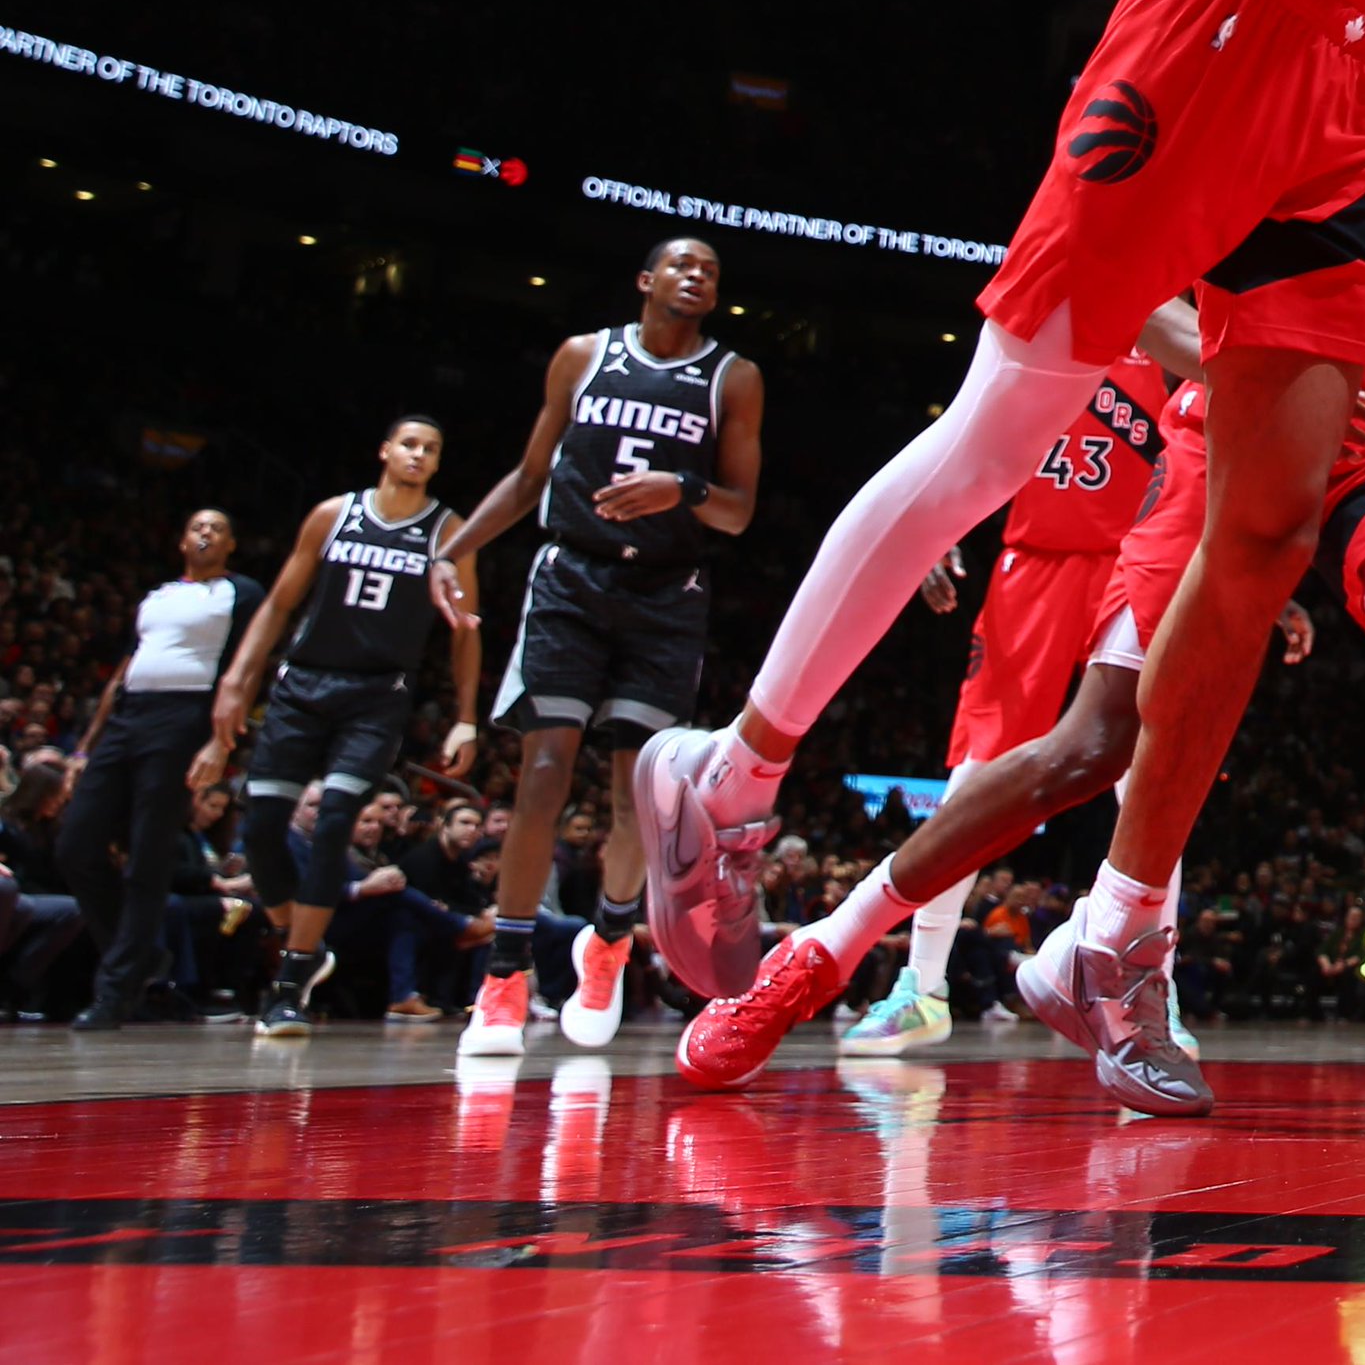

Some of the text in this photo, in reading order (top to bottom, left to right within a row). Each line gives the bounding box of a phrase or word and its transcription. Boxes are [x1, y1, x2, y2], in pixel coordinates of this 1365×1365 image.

[96, 55, 136, 83] OF
[136, 64, 185, 99] THE
[186, 78, 297, 128] TORONTO
[294, 109, 399, 156] RAPTORS
[581, 176, 1009, 265] OFFICIAL STYLE PARTNER OF THE TORONT
[576, 395, 709, 445] KINGS
[611, 435, 654, 485] 5
[1035, 434, 1114, 492] 43
[327, 540, 429, 576] KINGS
[344, 569, 394, 611] 13
